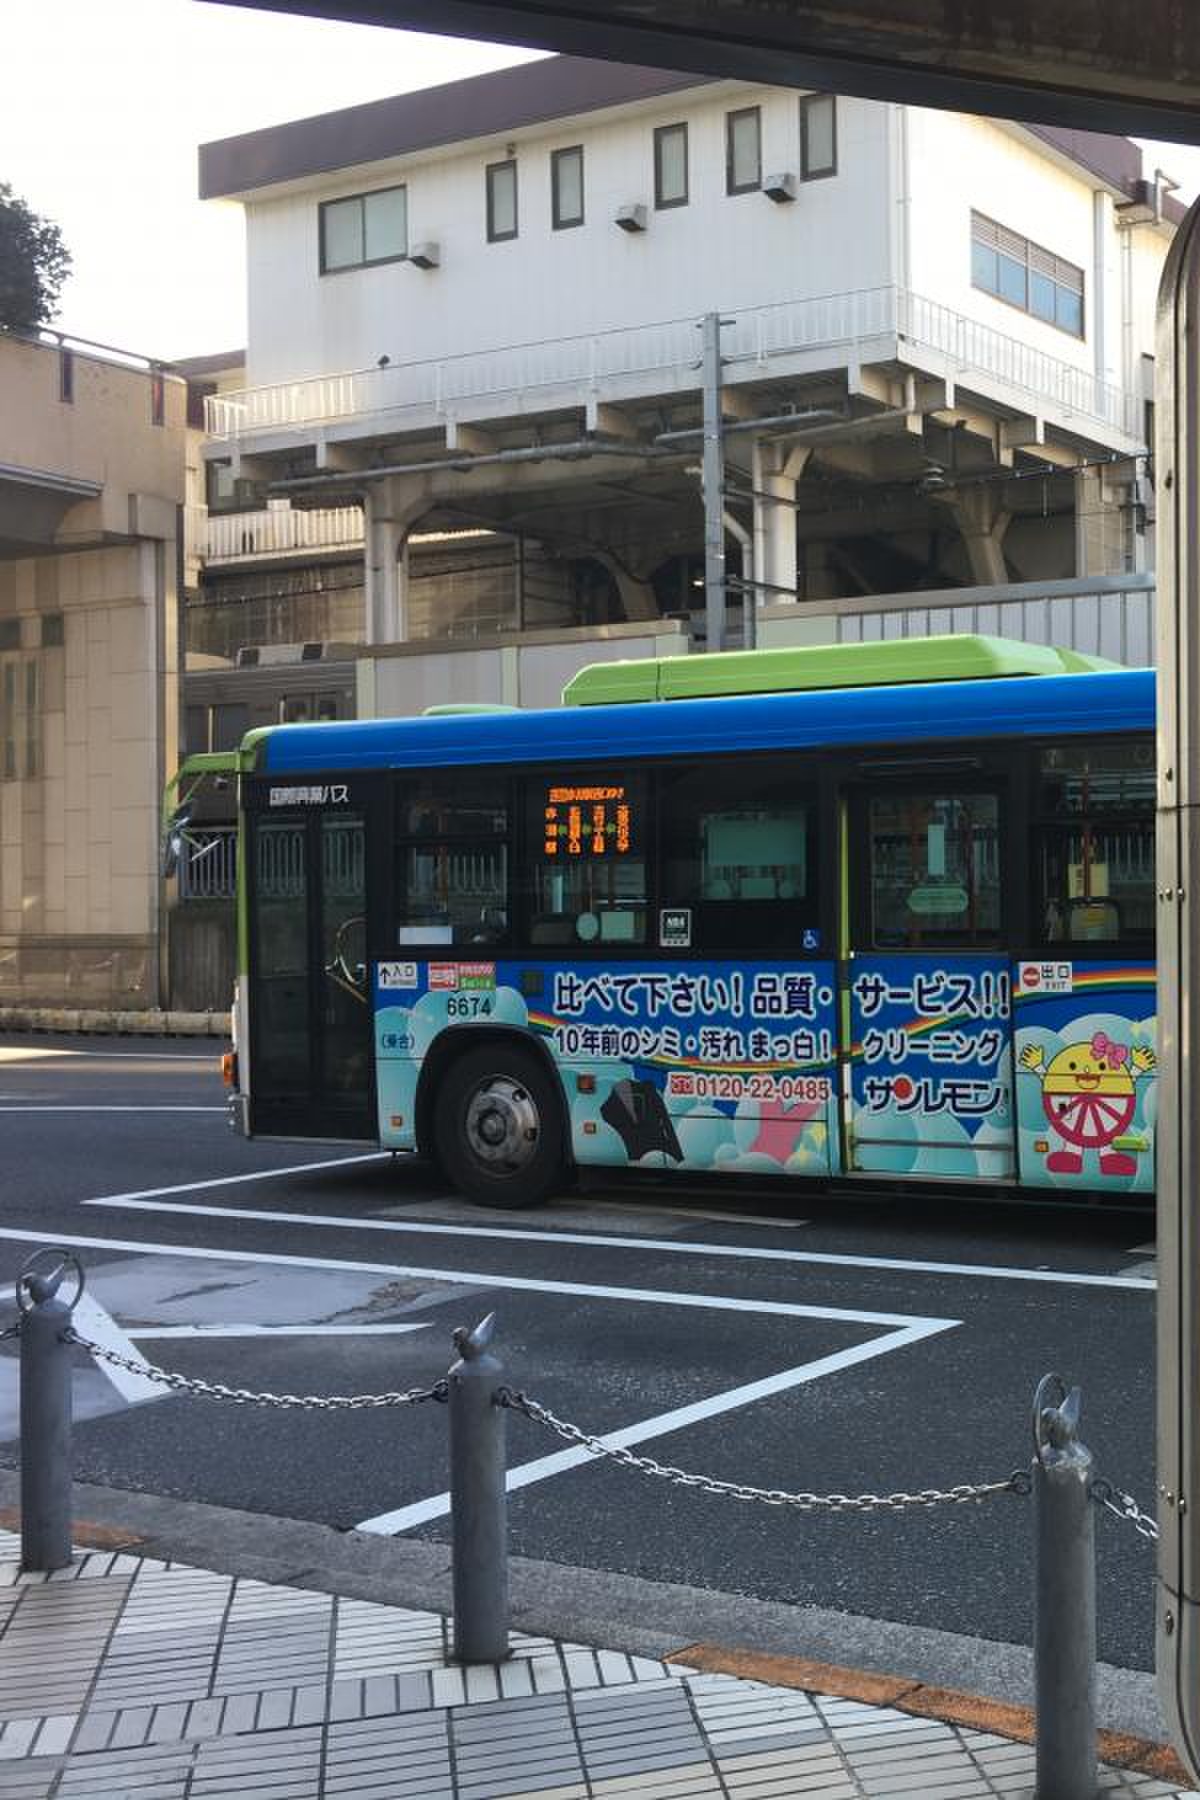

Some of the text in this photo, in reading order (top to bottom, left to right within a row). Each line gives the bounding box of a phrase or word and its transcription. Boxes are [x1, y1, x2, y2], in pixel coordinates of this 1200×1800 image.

[448, 997, 492, 1016] 6674
[865, 1031, 1000, 1064] クリーニング
[696, 1074, 830, 1100] 0120-22-0485
